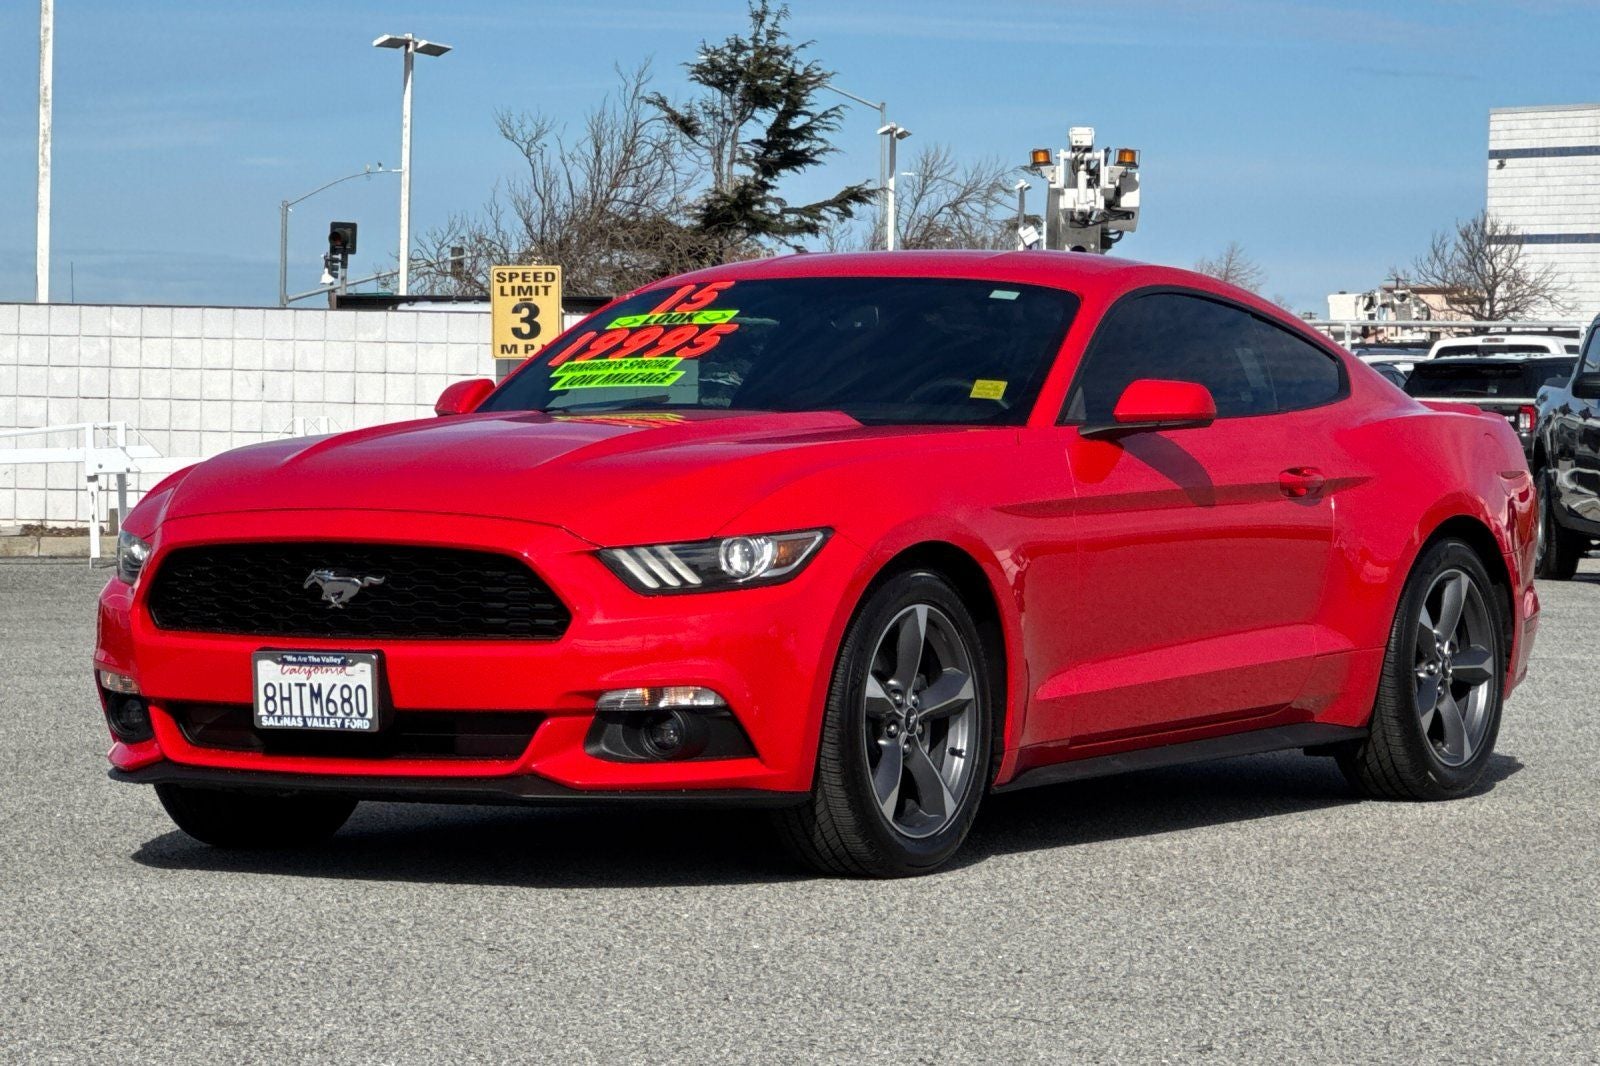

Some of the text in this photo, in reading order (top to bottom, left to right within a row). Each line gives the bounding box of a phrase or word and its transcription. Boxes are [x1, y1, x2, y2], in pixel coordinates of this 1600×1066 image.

[496, 271, 556, 283] SPEED
[500, 285, 552, 297] LIMIT
[648, 280, 736, 314] 15
[511, 301, 542, 340] 3
[643, 311, 705, 326] LOOK
[500, 344, 547, 355] MP
[547, 324, 740, 367] 19995
[558, 371, 679, 388] LOW MILEAGE
[308, 655, 320, 663] The
[281, 664, 354, 680] California
[263, 682, 368, 717] 8HTM680
[305, 717, 342, 728] VALLEY
[344, 718, 370, 730] FORD
